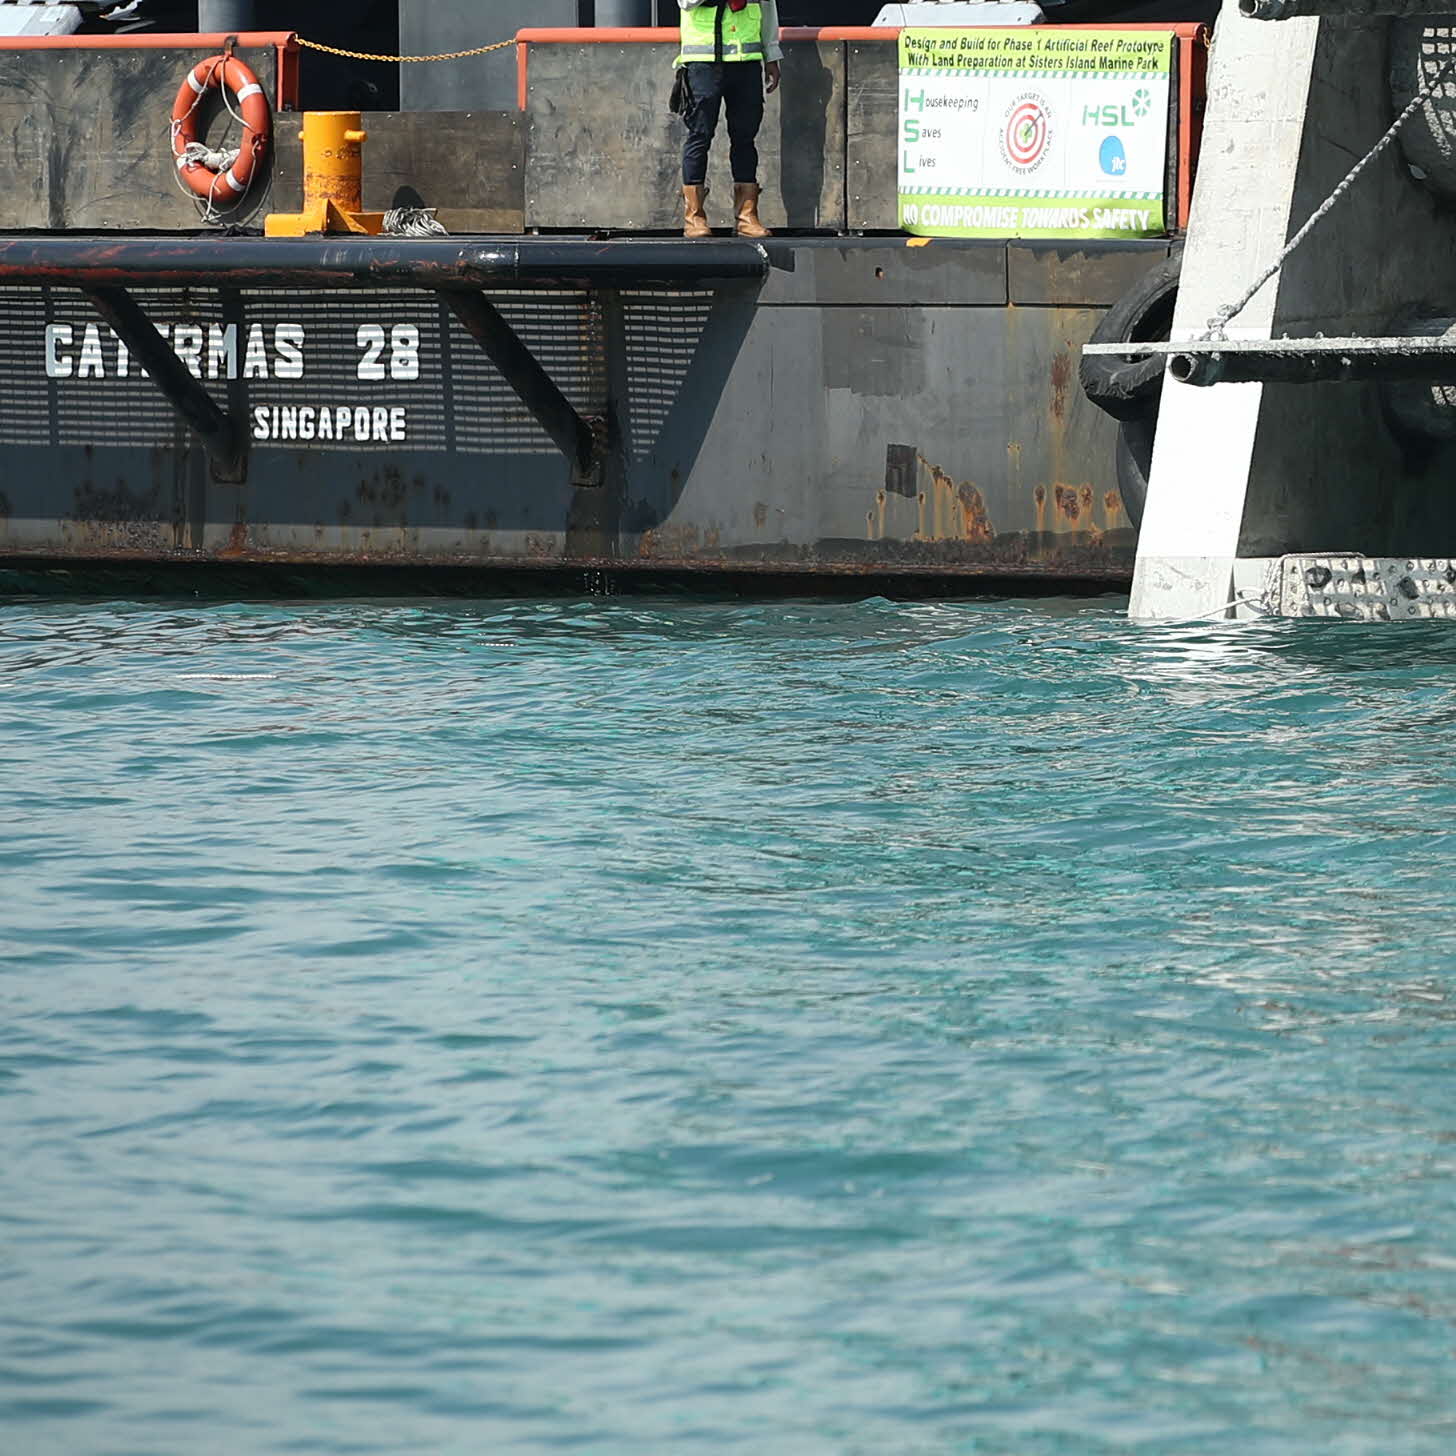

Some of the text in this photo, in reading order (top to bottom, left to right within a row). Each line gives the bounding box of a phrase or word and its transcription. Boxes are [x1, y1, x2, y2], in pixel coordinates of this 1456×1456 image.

[904, 35, 937, 52] Design
[940, 38, 958, 49] and
[960, 37, 985, 50] Build
[987, 38, 1001, 50] for
[1003, 38, 1033, 51] Phase
[1044, 38, 1088, 52] Artificial
[1091, 39, 1114, 52] Reef
[1116, 39, 1165, 55] Prototype
[908, 52, 1159, 70] With Land Preparation at Sisters Island Marine Park
[904, 88, 979, 112] Housekeeping
[1082, 104, 1135, 126] HSL
[904, 119, 942, 142] Saves
[904, 150, 936, 173] Lives
[903, 204, 1150, 230] NO COMPROMISE TOWARDS SAFETY
[45, 323, 419, 380] CATRMAS 28
[253, 405, 405, 442] SINGAPORE
